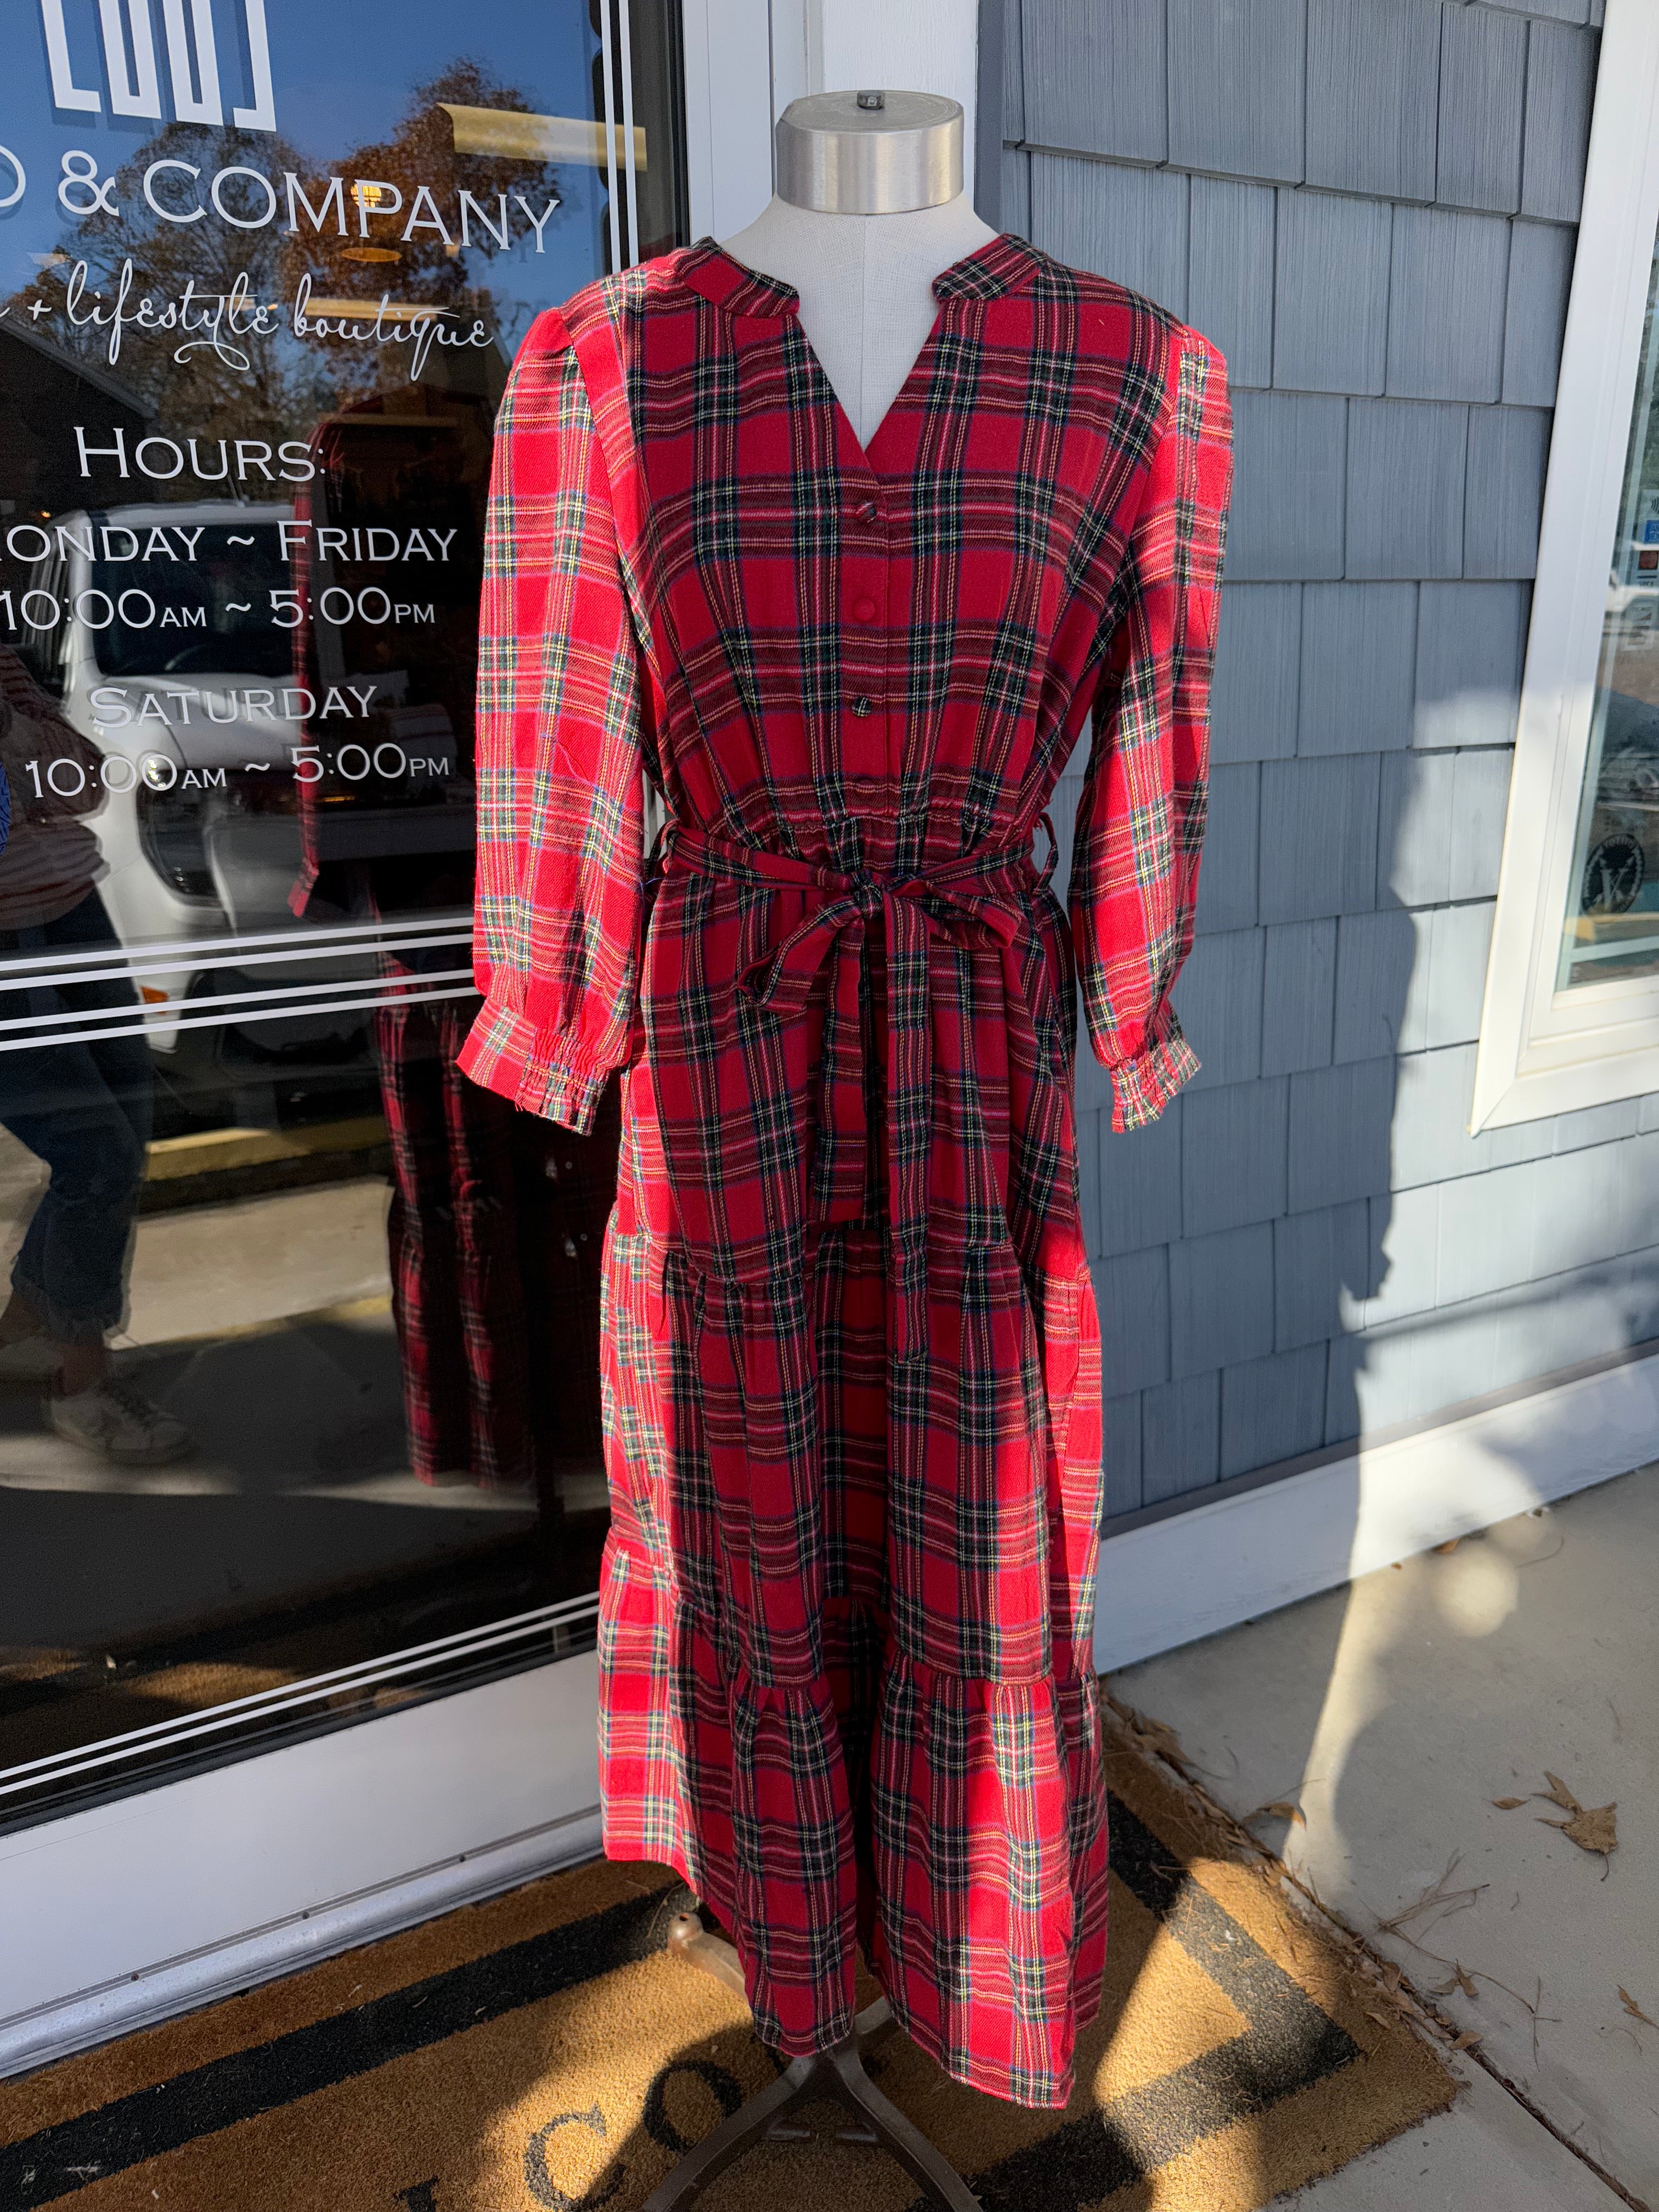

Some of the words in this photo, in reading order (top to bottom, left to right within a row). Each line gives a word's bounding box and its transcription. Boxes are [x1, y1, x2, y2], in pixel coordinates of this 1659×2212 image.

[59, 150, 119, 217] &
[144, 160, 560, 253] COMPANY
[67, 258, 279, 370] lifestyle
[294, 273, 493, 381] boutique
[74, 427, 325, 482] HOURS:
[0, 525, 205, 562] ONDAY
[277, 520, 457, 561] FRIDAY
[0, 589, 207, 630] 10:00AM
[269, 587, 435, 628] 5:00PM
[89, 685, 377, 728] SATURDAY
[25, 754, 227, 798] 10:00AM
[290, 743, 449, 782] 5:00PM
